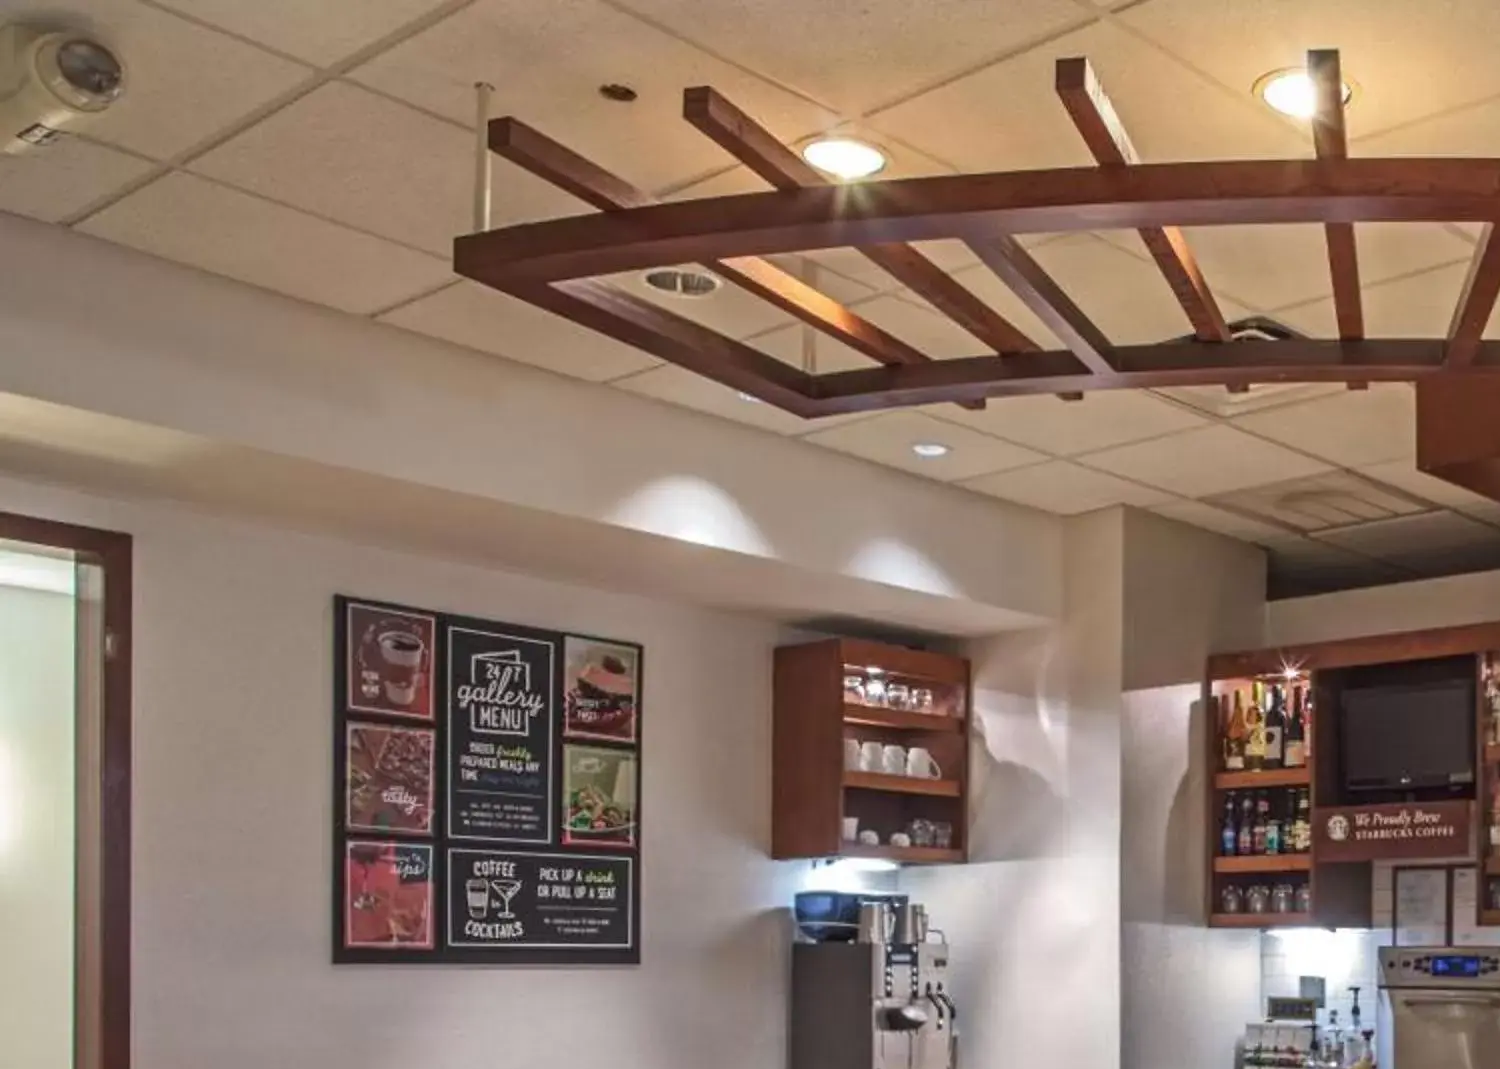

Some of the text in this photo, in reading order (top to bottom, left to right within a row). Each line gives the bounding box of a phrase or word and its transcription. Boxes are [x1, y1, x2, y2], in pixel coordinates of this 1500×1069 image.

[457, 665, 545, 717] gallery
[479, 704, 521, 730] MENU
[1415, 824, 1454, 838] COFFEE
[473, 859, 517, 878] COFFEE
[539, 867, 559, 881] PICK
[561, 867, 575, 881] UP
[575, 868, 583, 883] A
[551, 884, 572, 899] PULL
[465, 919, 524, 939] COCKTAILS
